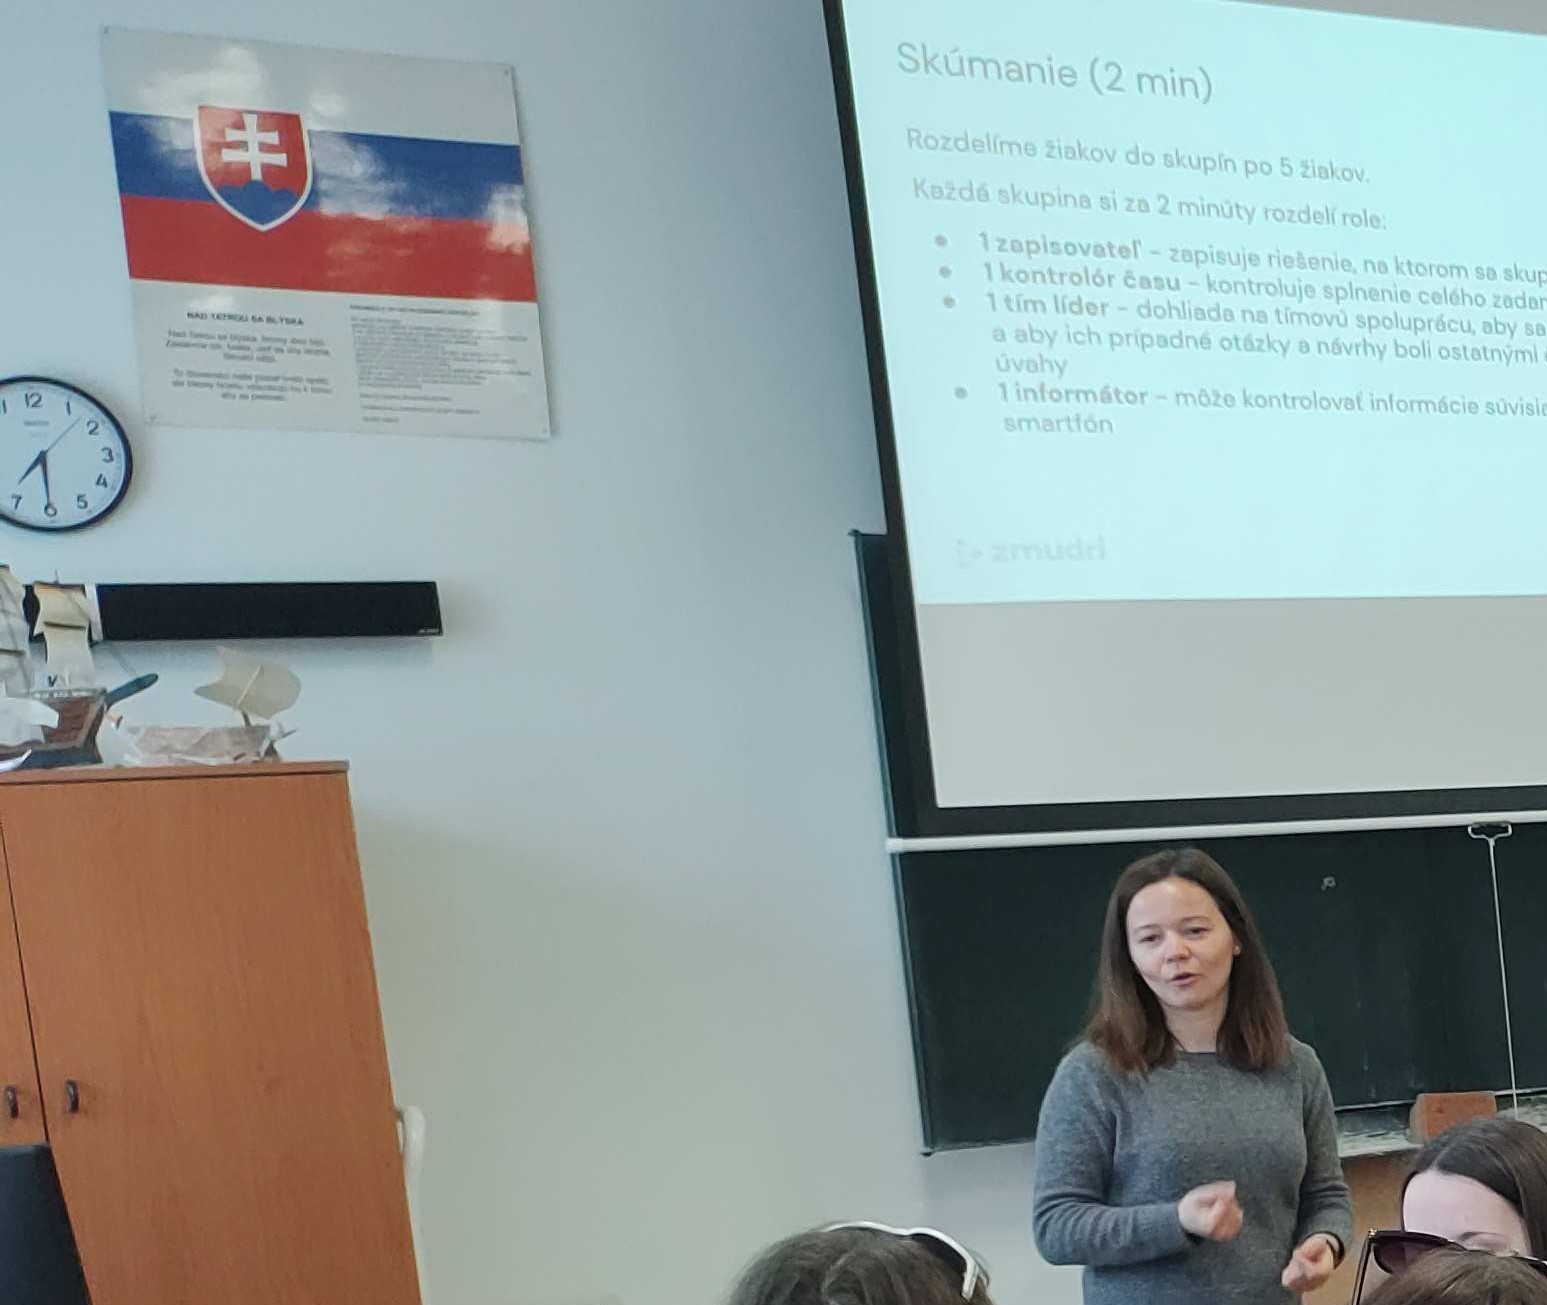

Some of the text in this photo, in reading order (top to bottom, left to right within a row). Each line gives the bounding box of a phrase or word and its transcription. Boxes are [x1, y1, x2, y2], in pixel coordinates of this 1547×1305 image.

[897, 42, 1213, 104] Skúmanie (2 min)
[907, 127, 1371, 184] Rozdelíme žiakov do skupín po 5 žiakov.
[912, 177, 990, 202] Každá
[998, 184, 1092, 211] skupina
[1099, 190, 1119, 212] si
[1125, 196, 1151, 213] za
[1157, 194, 1171, 215] 2
[1177, 197, 1256, 225] minúty
[1342, 208, 1387, 230] role:
[979, 232, 990, 252] 1
[1169, 244, 1261, 271] zapisuje
[1363, 259, 1389, 276] na
[1394, 256, 1469, 280] ktorom
[1475, 265, 1498, 281] sa
[984, 262, 993, 283] 1
[1123, 268, 1181, 292] času
[1206, 273, 1316, 302] kontroluje
[1323, 281, 1411, 305] splnenie
[1417, 287, 1487, 308] celého
[987, 292, 997, 312] 1
[1003, 293, 1047, 315] tím
[1136, 298, 1235, 323] dohliada
[1241, 309, 1268, 324] na
[1482, 317, 1518, 340] aby
[1524, 323, 1547, 338] sa
[991, 328, 1007, 343] a
[1013, 323, 1058, 350] aby
[1066, 324, 1102, 346] ich
[1219, 332, 1291, 358] otázky
[1298, 339, 1311, 355] a
[1317, 337, 1388, 362] návrhy
[1394, 339, 1433, 360] boli
[1438, 343, 1538, 366] ostatnými
[995, 353, 1069, 379] úvahy
[24, 392, 43, 409] 12
[998, 382, 1008, 402] 1
[1015, 382, 1149, 406] informátor
[66, 401, 71, 417] 1
[86, 420, 100, 436] 2
[101, 447, 114, 463] 3
[95, 473, 108, 488] 4
[11, 494, 22, 511] 7
[76, 494, 89, 510] 5
